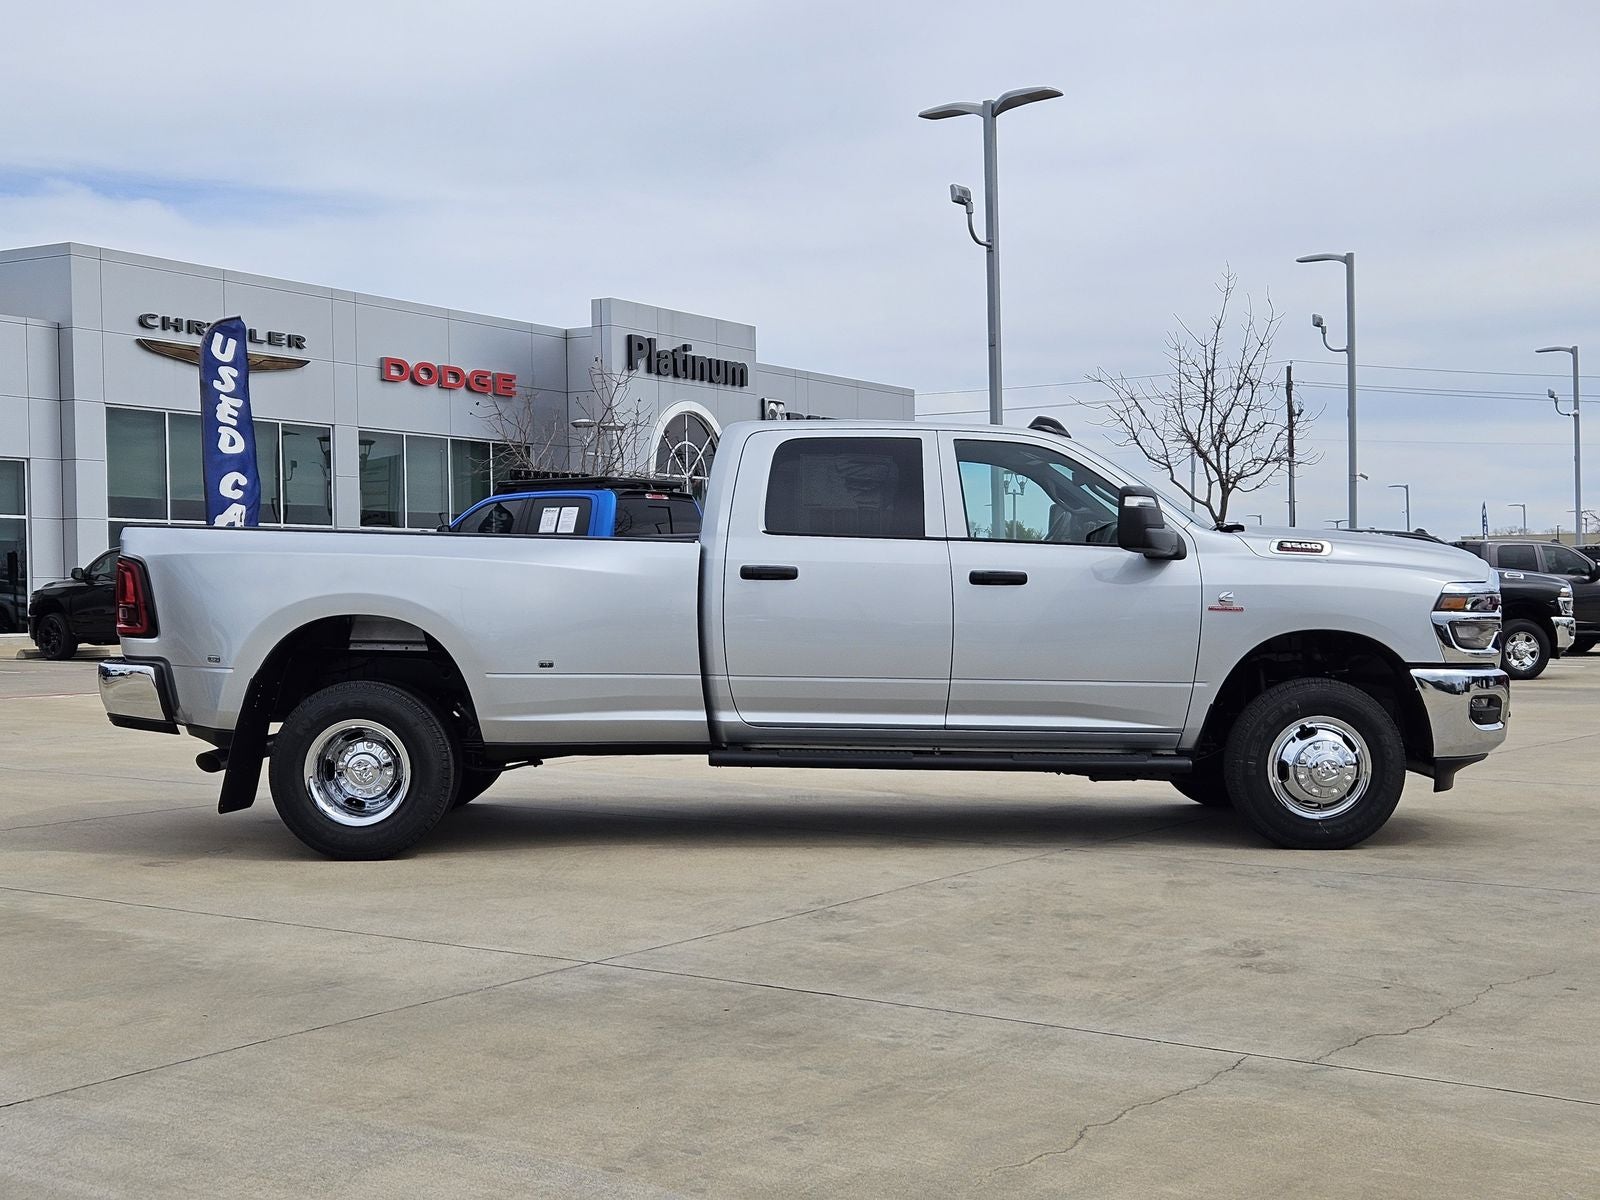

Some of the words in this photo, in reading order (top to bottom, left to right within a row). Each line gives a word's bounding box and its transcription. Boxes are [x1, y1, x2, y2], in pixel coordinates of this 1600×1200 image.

[138, 313, 306, 349] CHRLER
[381, 356, 517, 397] DODGE
[627, 334, 748, 387] Platinum
[210, 332, 246, 454] USED
